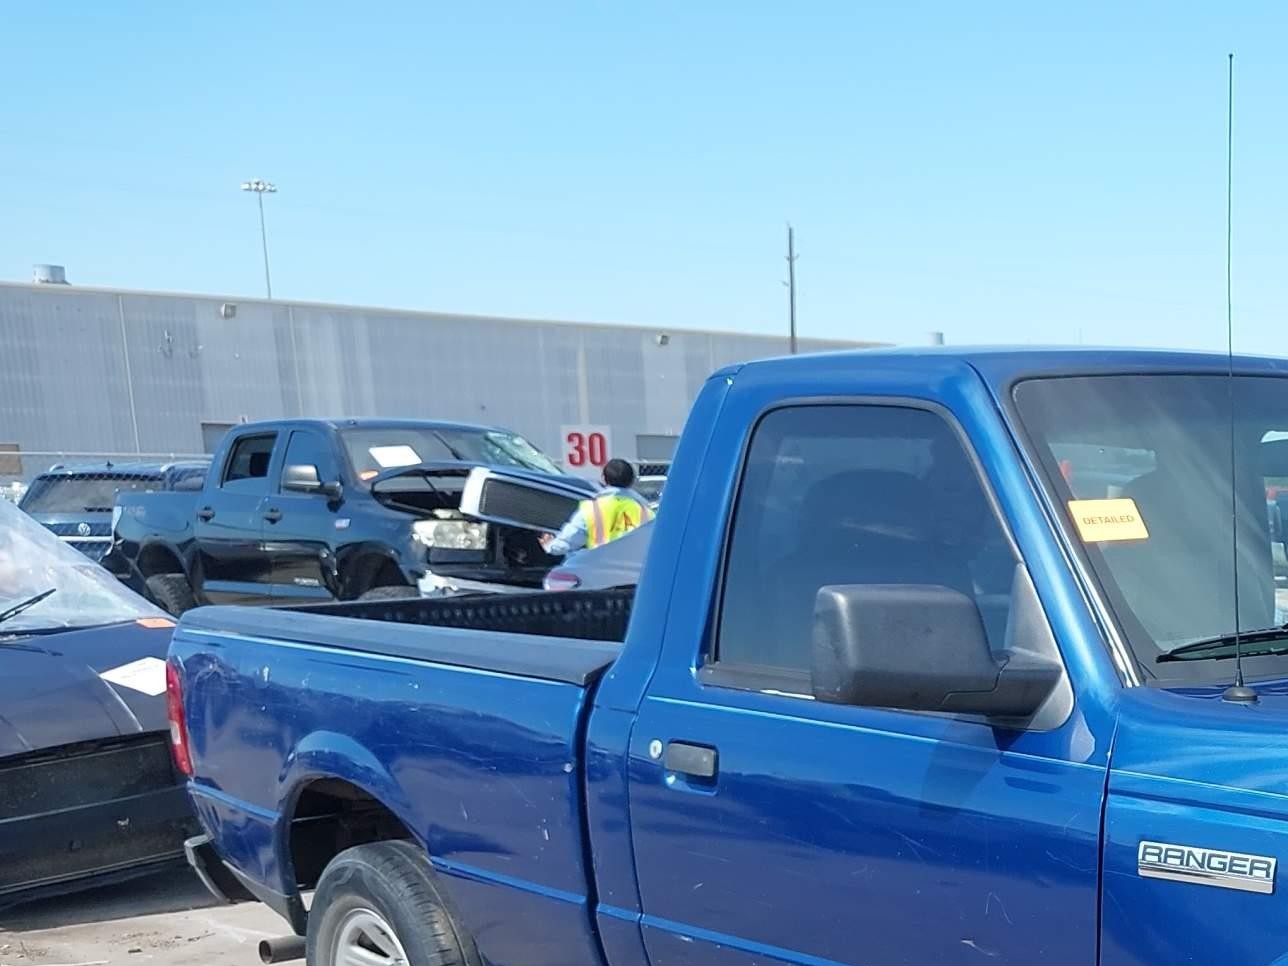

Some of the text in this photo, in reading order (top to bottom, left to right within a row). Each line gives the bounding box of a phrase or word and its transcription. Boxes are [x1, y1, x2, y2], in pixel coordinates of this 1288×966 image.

[567, 432, 607, 467] 30
[1082, 514, 1136, 526] DETAILED
[1140, 843, 1273, 879] RANGER
